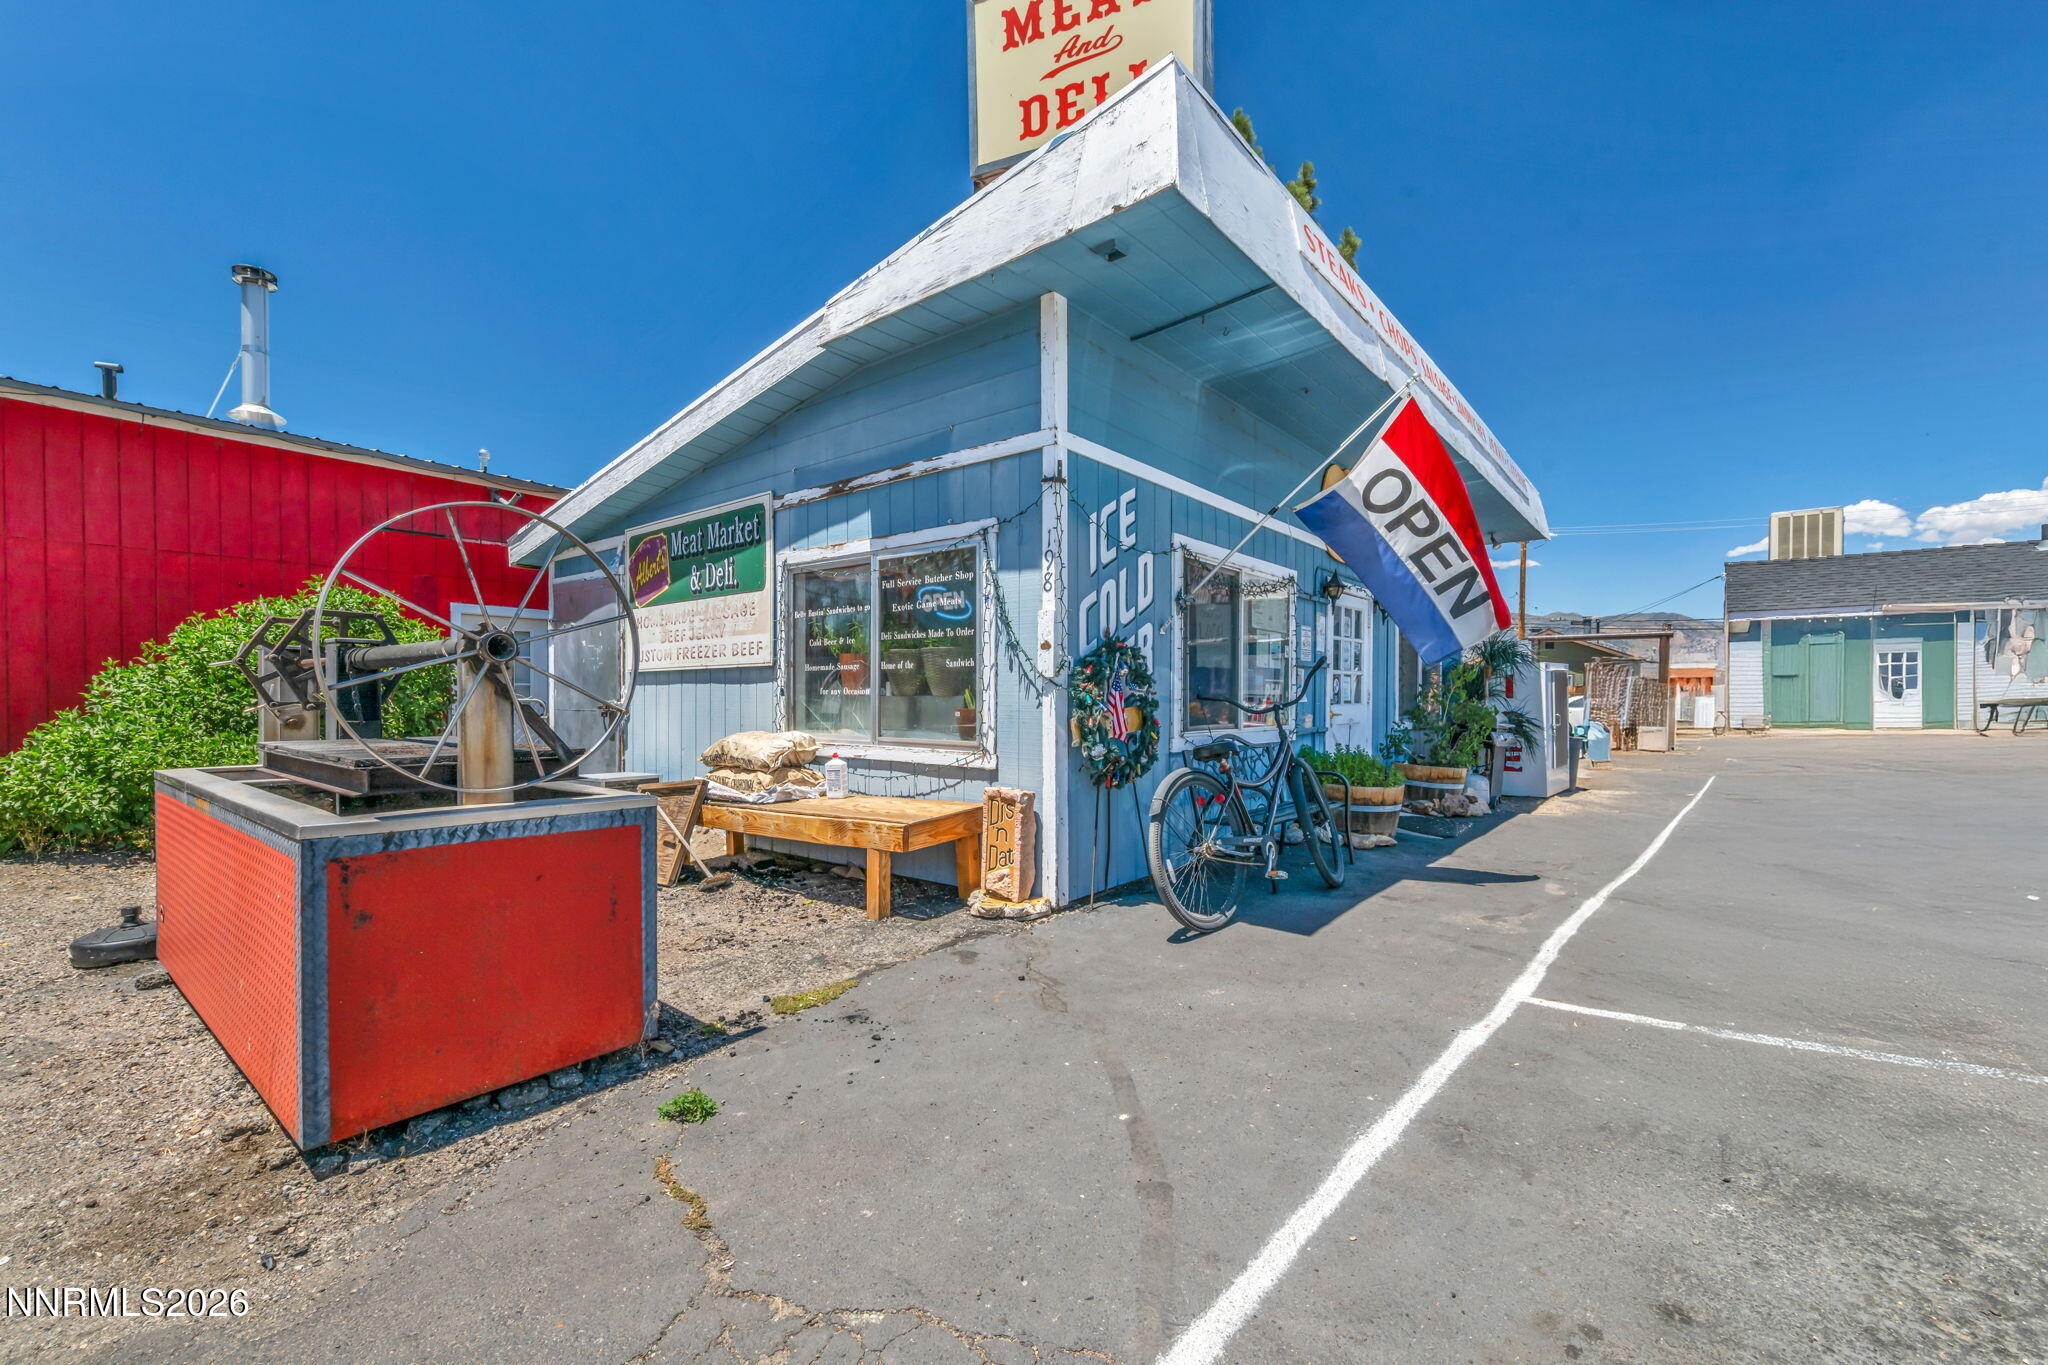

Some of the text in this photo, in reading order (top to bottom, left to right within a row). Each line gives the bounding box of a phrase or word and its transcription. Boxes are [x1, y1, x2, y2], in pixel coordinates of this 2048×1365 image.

[1050, 24, 1123, 67] And
[1303, 224, 1367, 307] STEAKS
[1379, 311, 1418, 365] CHOPS
[670, 513, 761, 558] Meat Market
[1089, 487, 1136, 576] ICE
[1362, 468, 1492, 620] OPEN
[690, 564, 701, 591] &
[881, 570, 974, 589] Full Service Butcher Shop
[826, 604, 856, 616] Sandwiches
[857, 604, 863, 612] to
[892, 596, 962, 612] Exotic Game Meats
[922, 590, 965, 612] OPEN
[1079, 551, 1153, 657] COLD
[808, 639, 822, 648] Cold
[823, 638, 838, 646] Beer
[881, 626, 975, 640] Deli Sandwiches Made To Order
[676, 644, 727, 661] FREEZER
[731, 641, 763, 657] BEEF
[804, 662, 860, 673] Homemade Sausage
[881, 657, 975, 672] Home of the Sandwich
[820, 687, 871, 697] for any Occasion
[987, 845, 1014, 872] Dat
